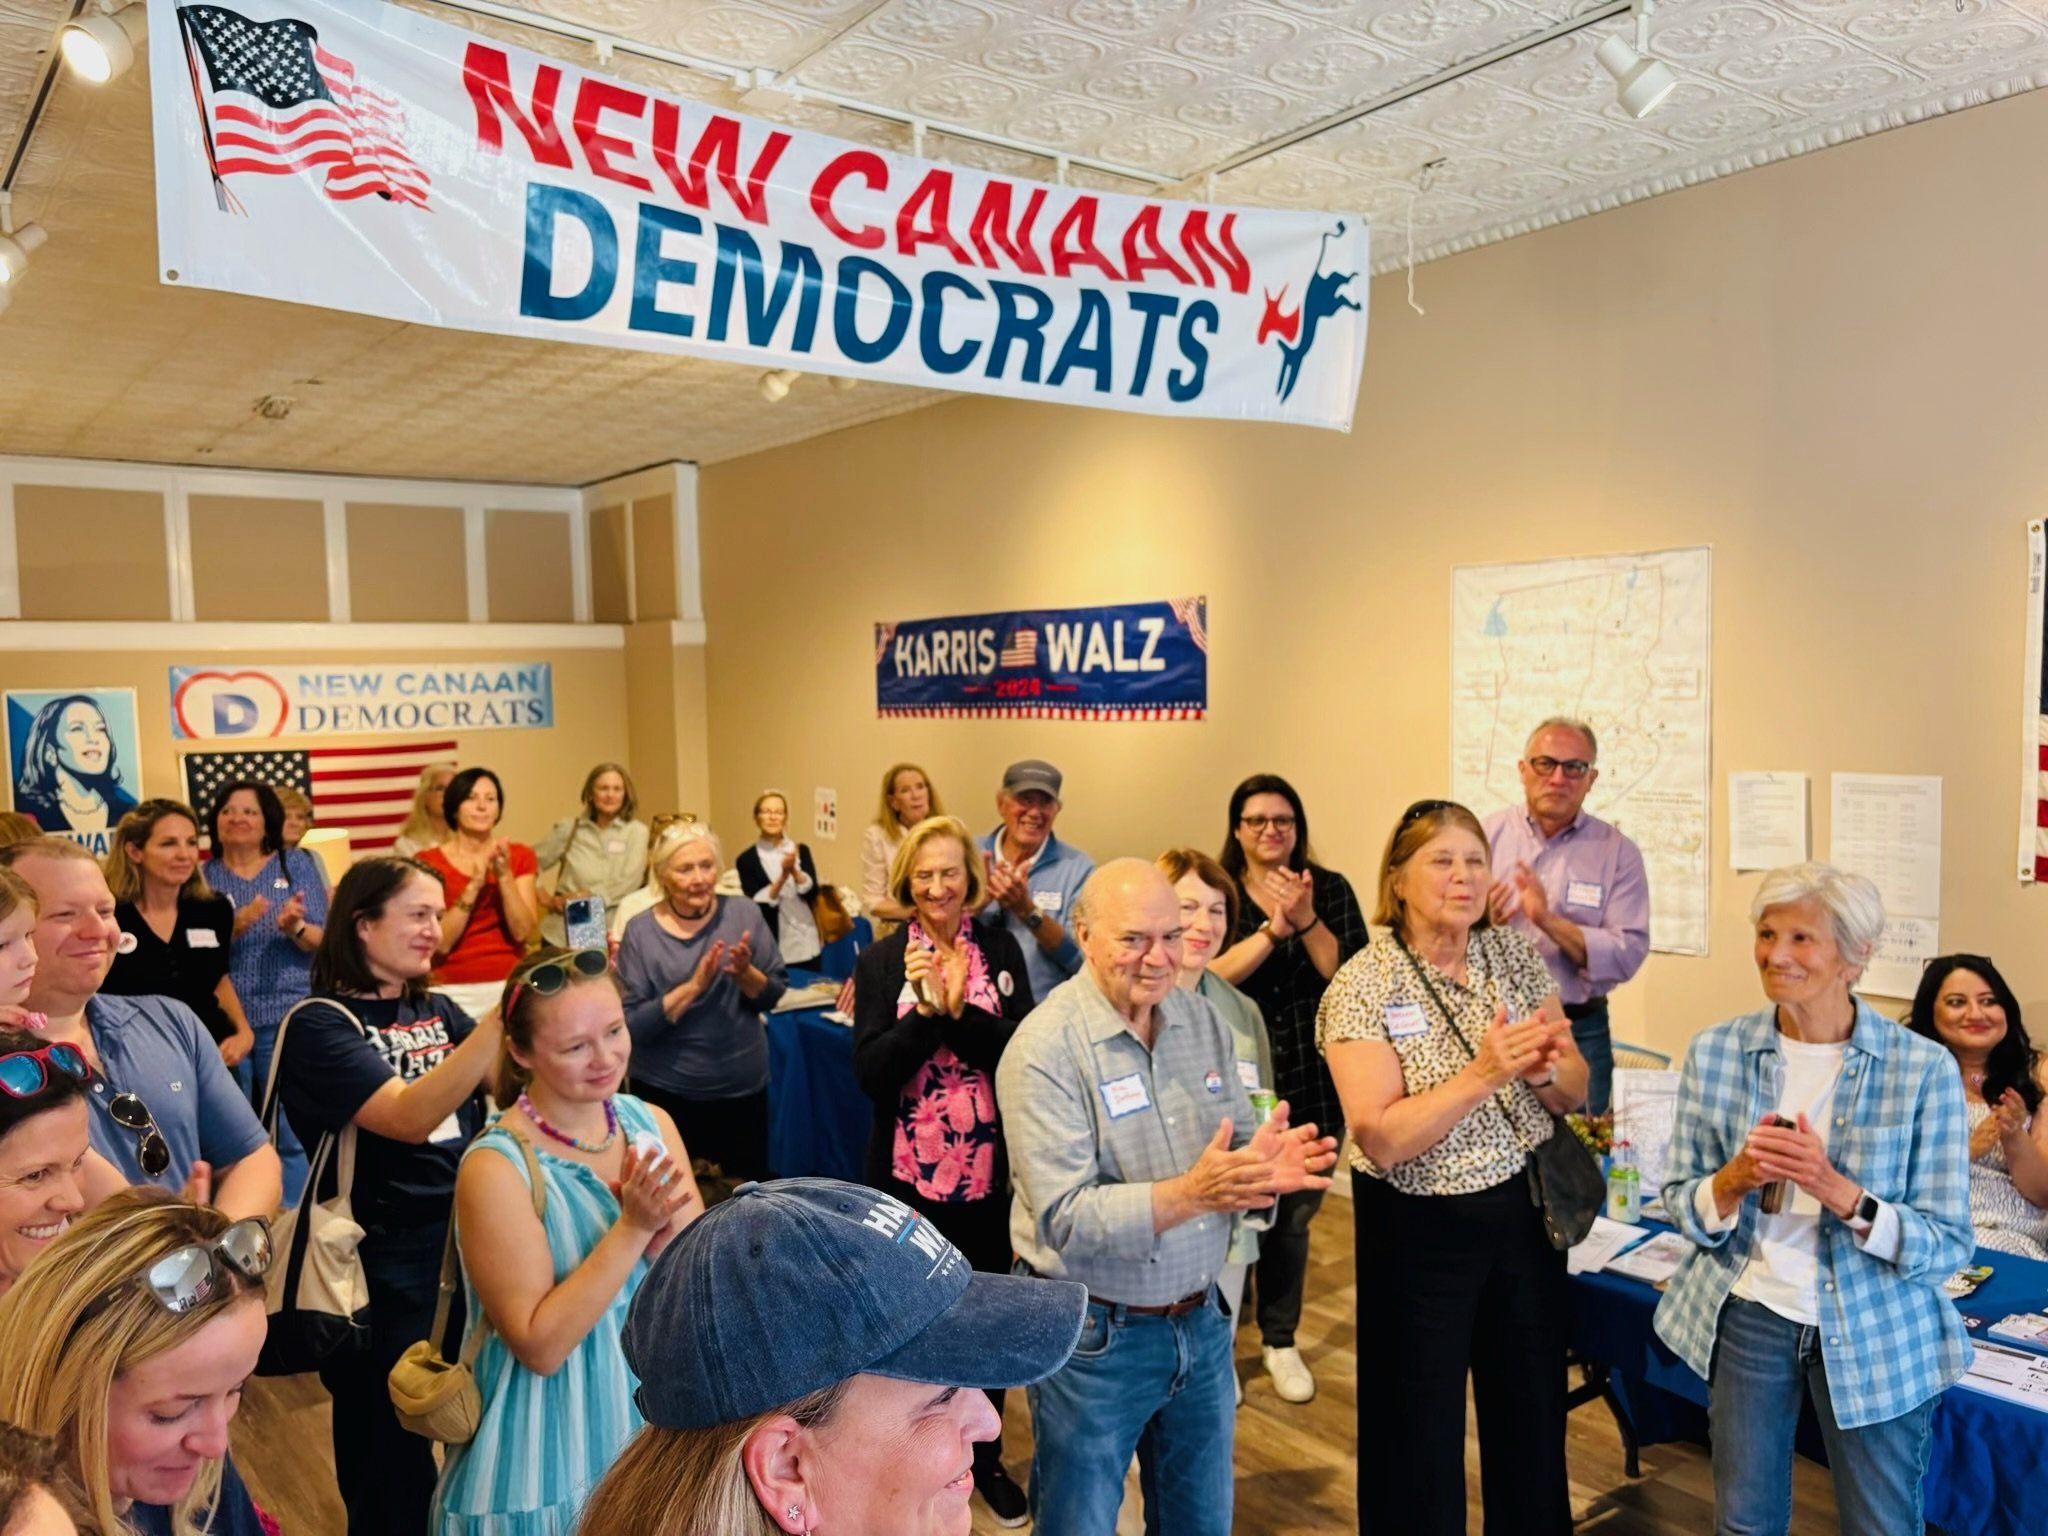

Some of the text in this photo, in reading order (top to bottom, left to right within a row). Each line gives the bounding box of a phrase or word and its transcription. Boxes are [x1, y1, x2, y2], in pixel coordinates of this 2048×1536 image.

[462, 41, 1252, 294] NEW CANAAN
[520, 181, 1219, 402] DEMOCRATS
[894, 617, 1166, 678] HARRIS WALZ
[297, 670, 538, 697] NEW CANAAN
[992, 677, 1041, 697] 2024
[211, 693, 259, 735] D
[297, 698, 545, 732] DEMOCRATS
